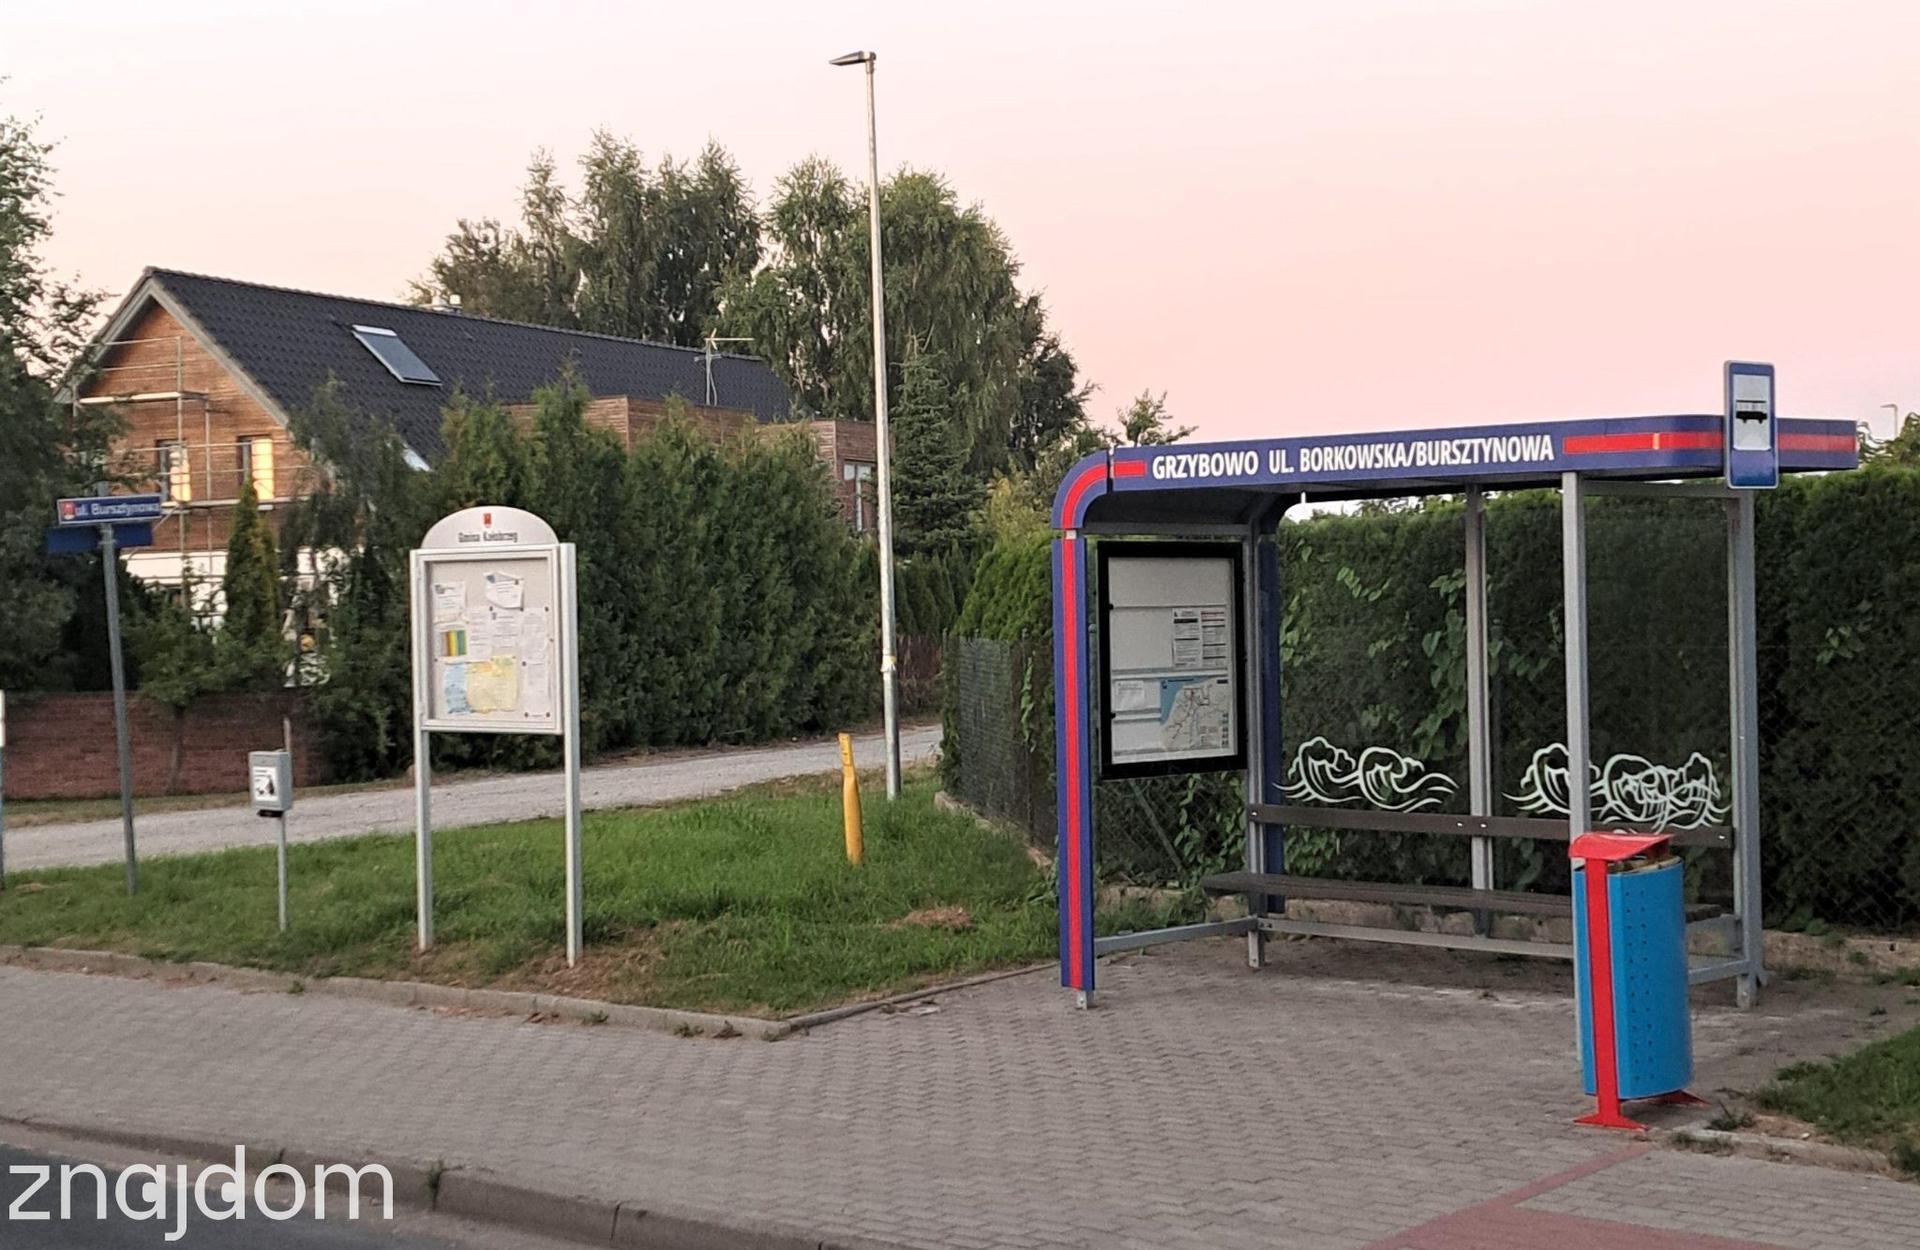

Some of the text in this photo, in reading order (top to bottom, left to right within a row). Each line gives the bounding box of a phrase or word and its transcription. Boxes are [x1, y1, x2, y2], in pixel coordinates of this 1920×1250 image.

[1152, 434, 1555, 479] GRZYBOWO UL. BORKOWSKA/BURSZTYNOWA
